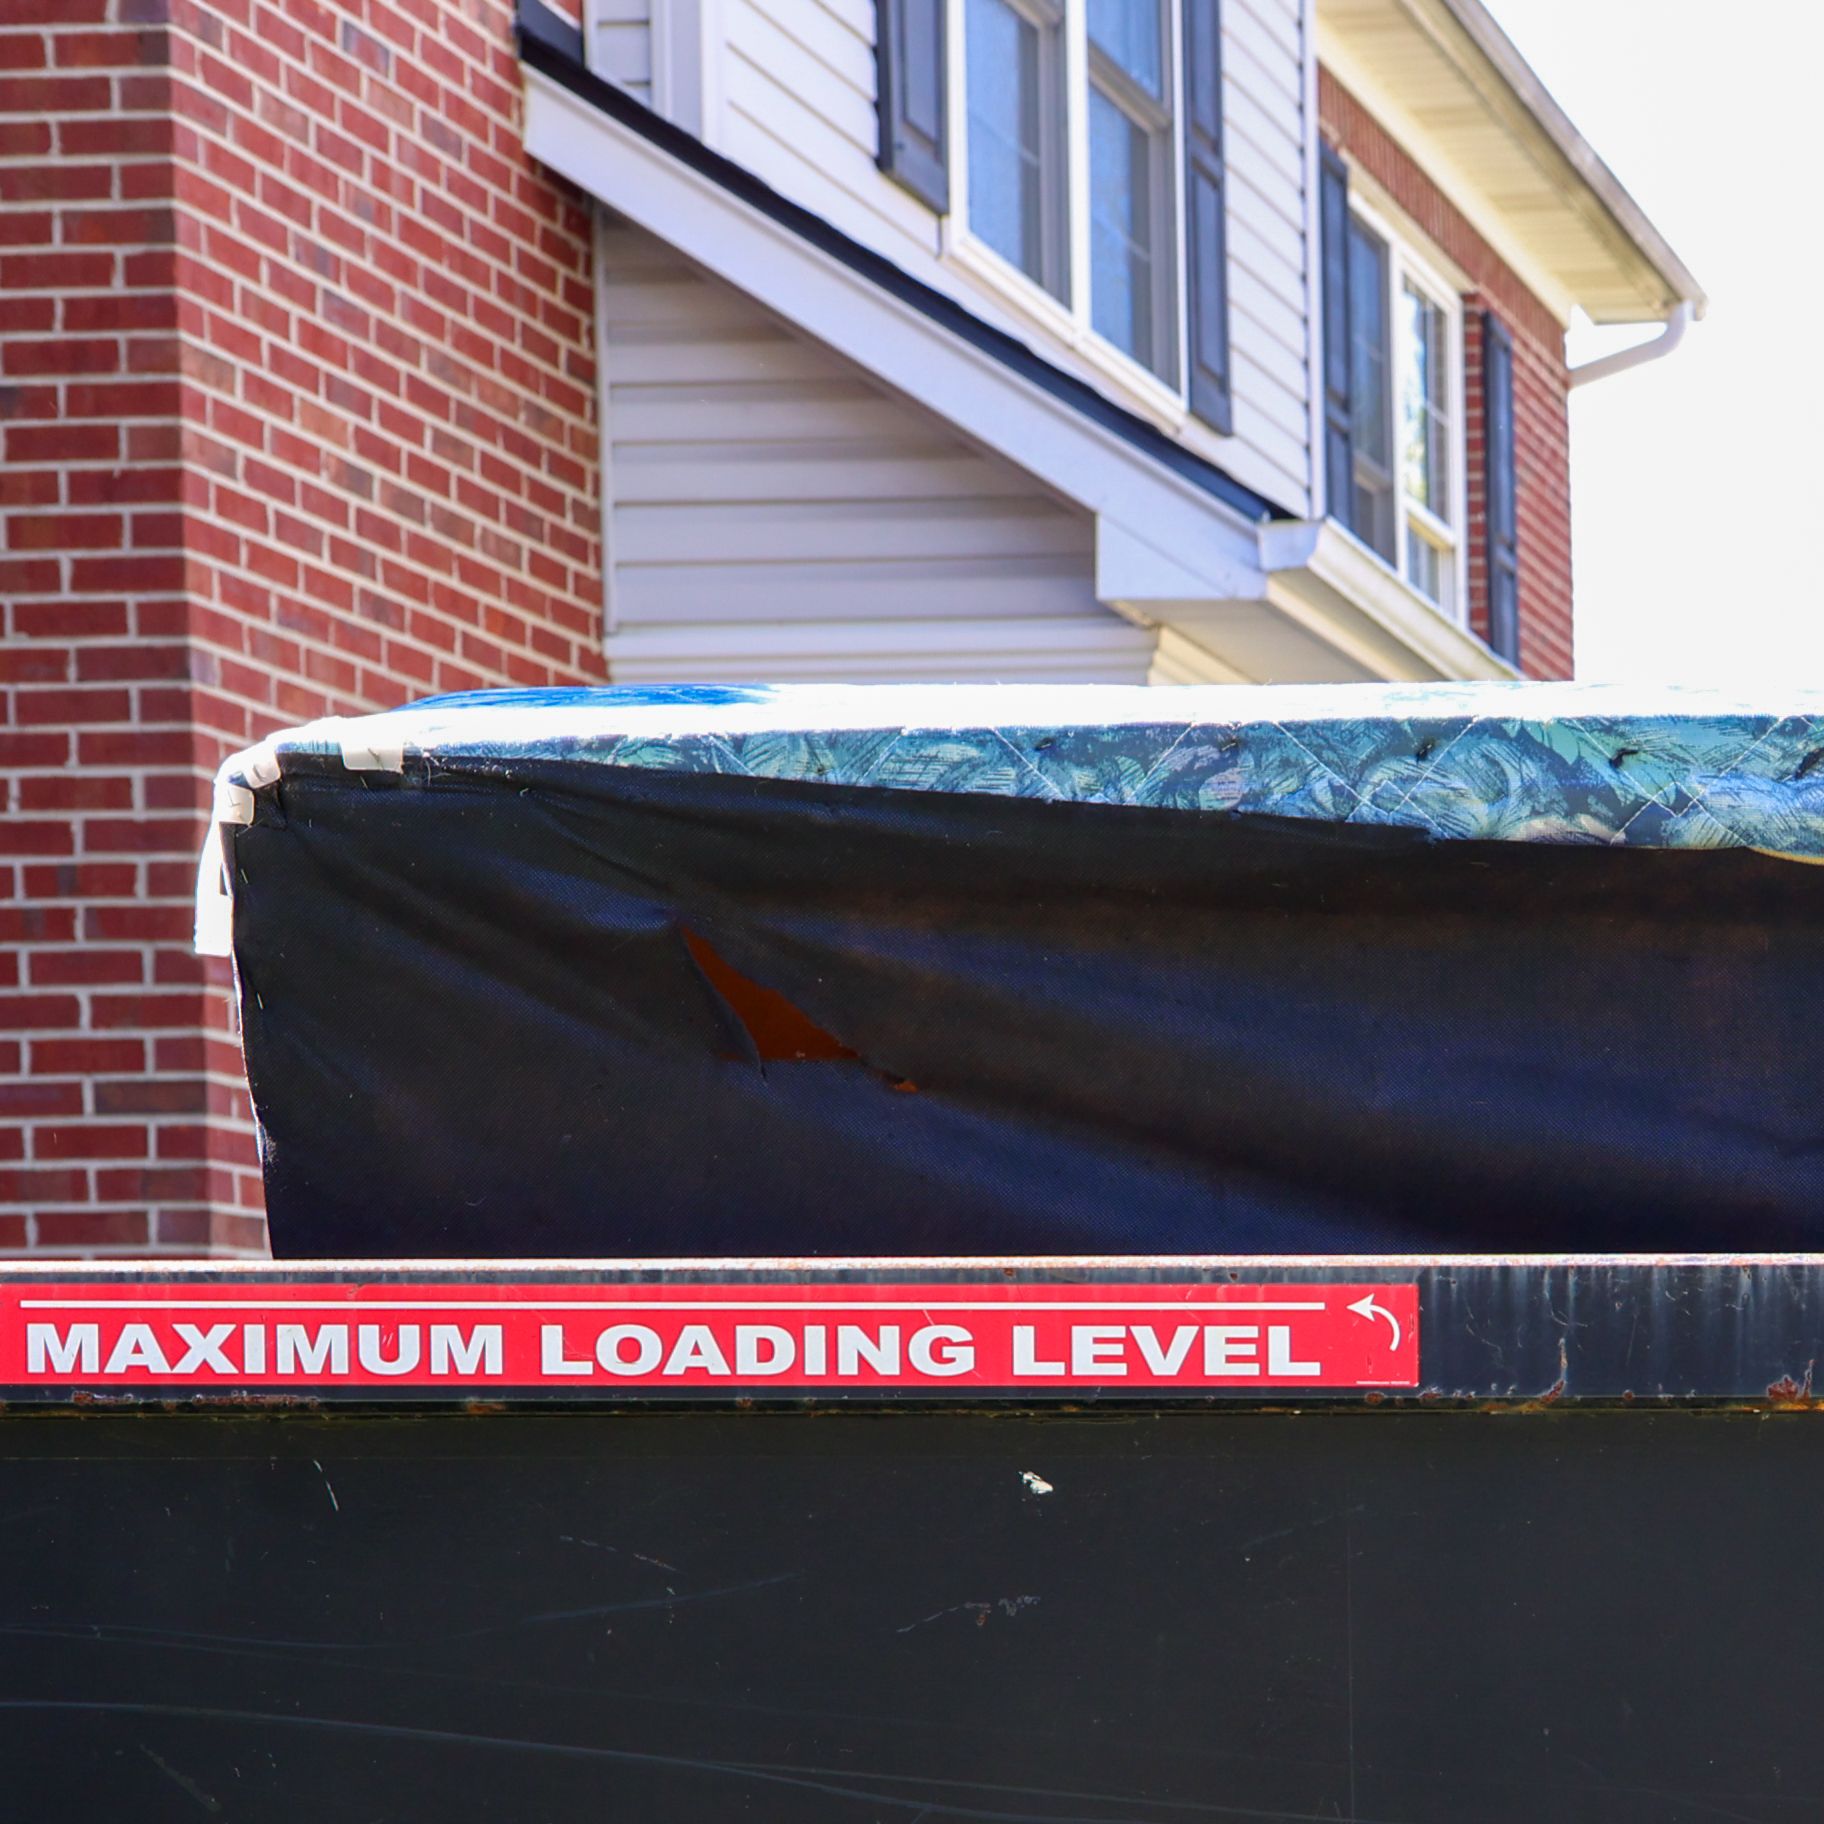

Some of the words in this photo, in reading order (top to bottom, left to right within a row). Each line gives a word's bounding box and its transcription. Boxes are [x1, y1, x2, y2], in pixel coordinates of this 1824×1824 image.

[26, 1323, 503, 1376] MAXIMUM
[540, 1323, 976, 1378] LOADING
[1011, 1324, 1322, 1377] LEVEL
